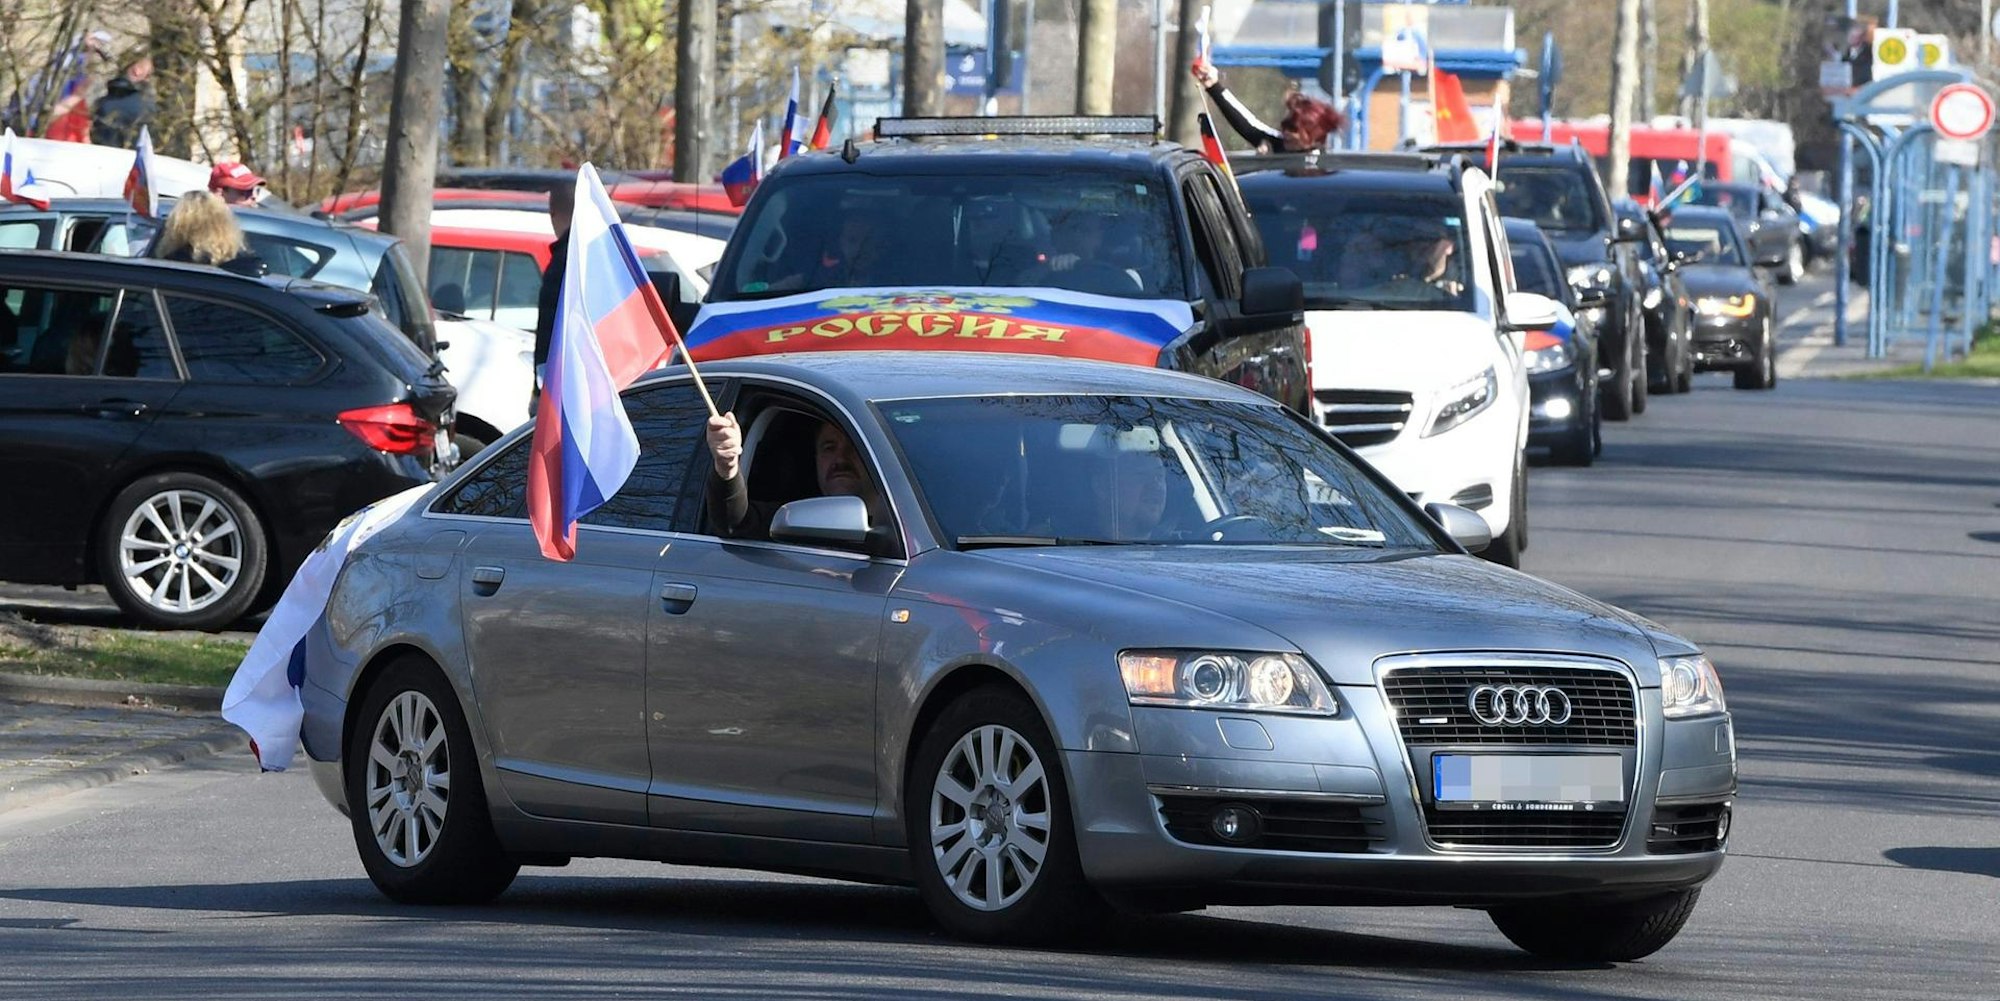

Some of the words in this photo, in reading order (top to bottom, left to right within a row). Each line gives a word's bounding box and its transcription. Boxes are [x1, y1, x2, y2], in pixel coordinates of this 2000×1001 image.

[764, 313, 1071, 343] РОССИЯ
[1492, 803, 1514, 811] CROLL
[1525, 803, 1574, 811] SONDERMANN
